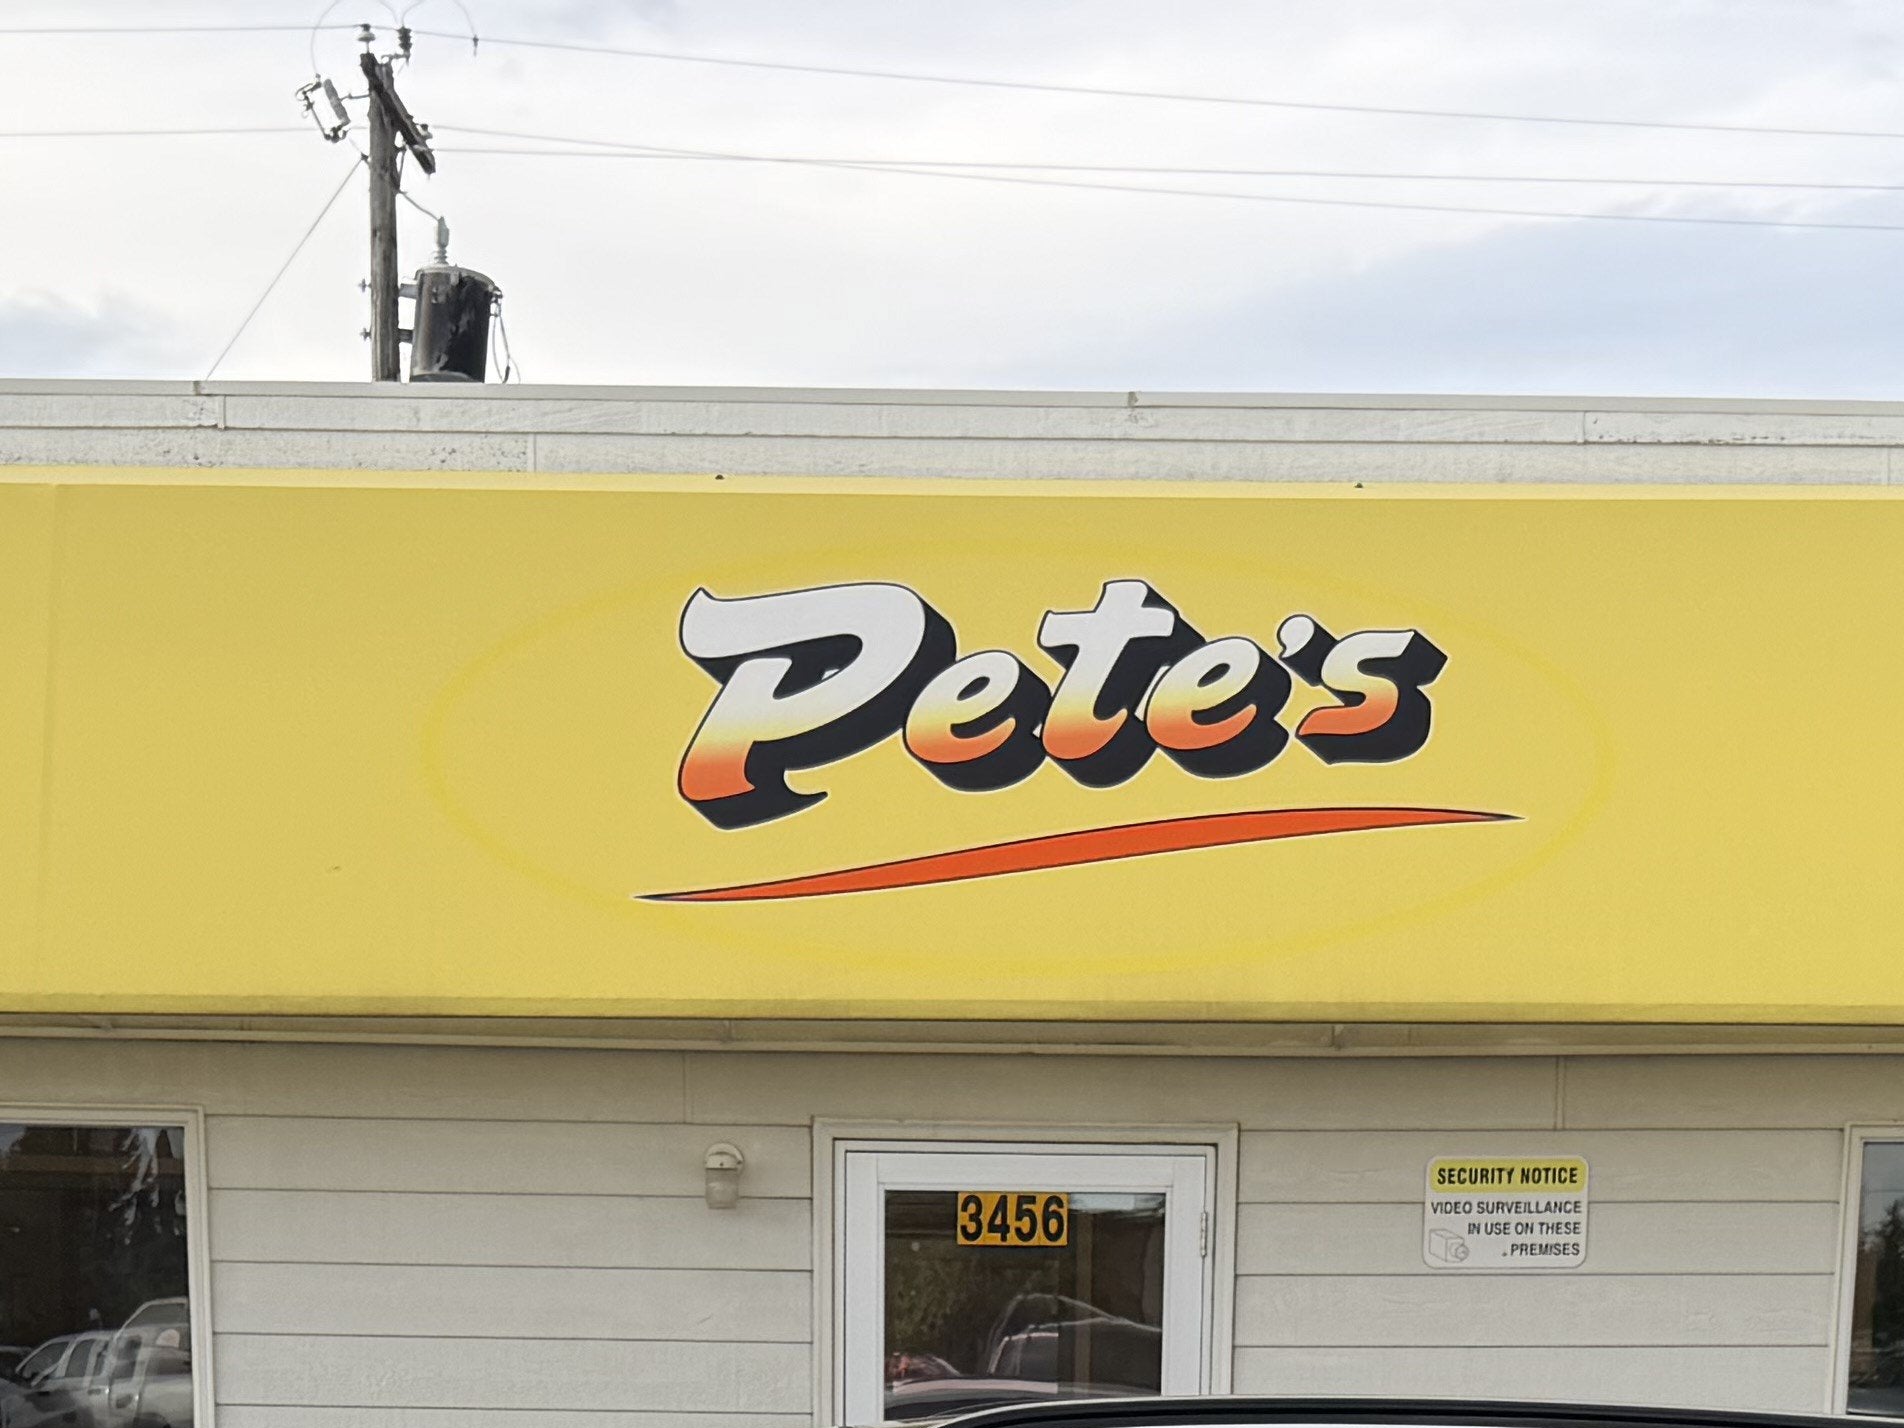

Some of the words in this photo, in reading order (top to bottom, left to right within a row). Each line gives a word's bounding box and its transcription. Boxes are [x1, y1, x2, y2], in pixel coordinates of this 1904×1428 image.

[677, 579, 1448, 831] Pete's
[1437, 1166, 1515, 1185] SECURITY
[1520, 1166, 1579, 1184] NOTICE
[1430, 1200, 1473, 1215] VIDEO
[1476, 1200, 1582, 1215] SURVEILLANCE
[960, 1194, 1065, 1243] 3456
[1467, 1222, 1481, 1236] IN
[1484, 1221, 1511, 1236] USE
[1514, 1221, 1535, 1236] ON
[1538, 1221, 1581, 1235] THESE
[1510, 1242, 1581, 1257] PREMISES
